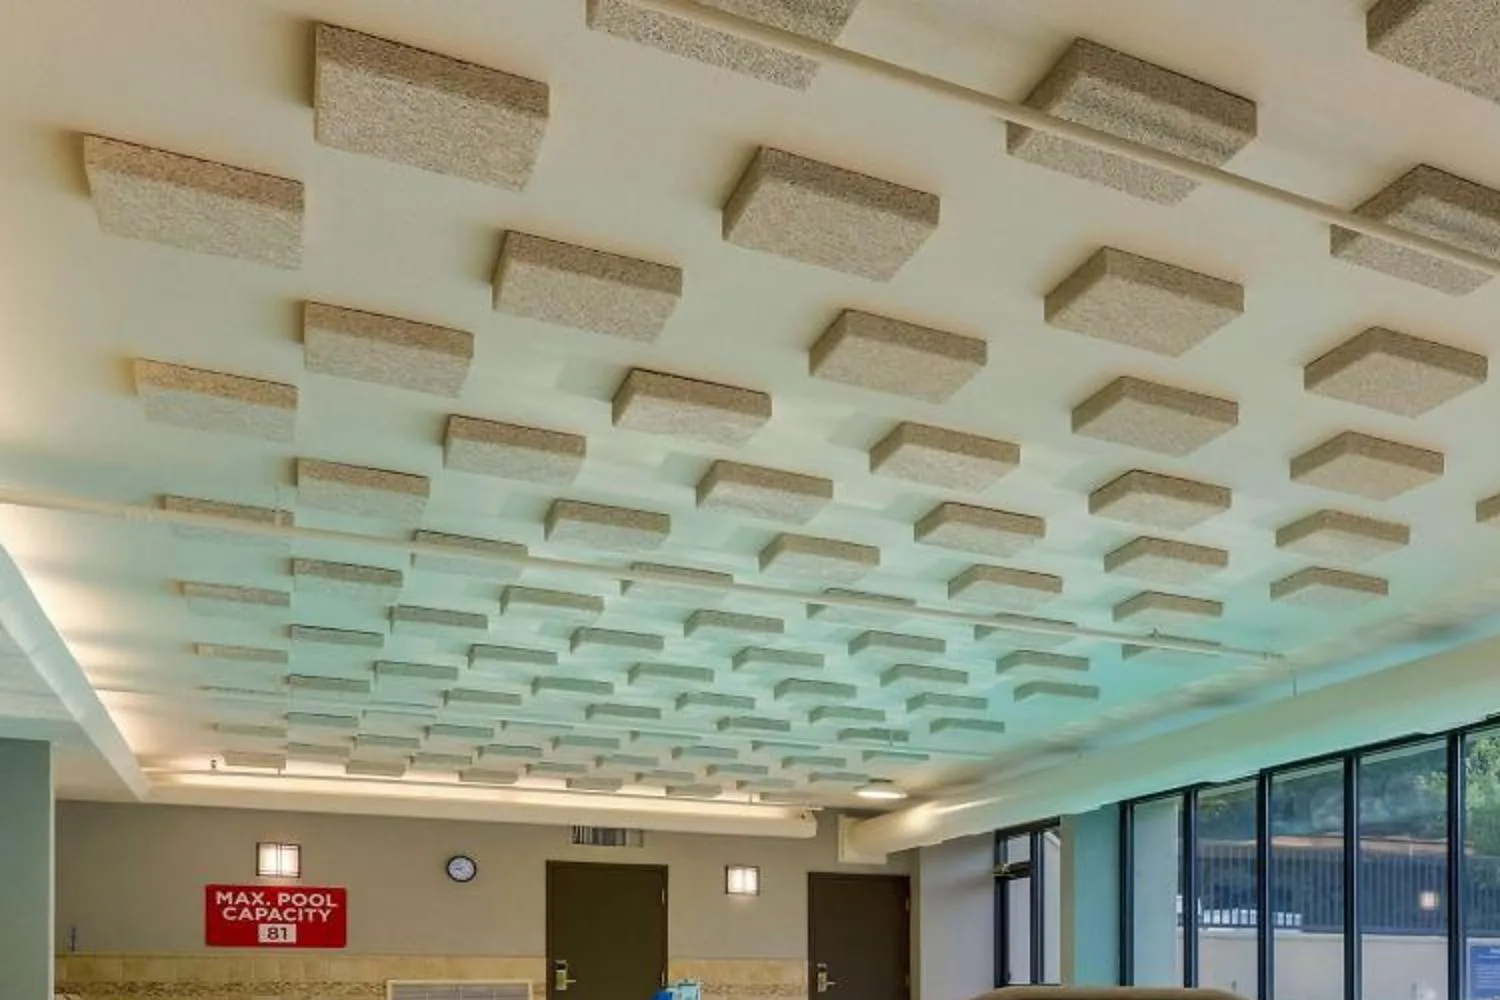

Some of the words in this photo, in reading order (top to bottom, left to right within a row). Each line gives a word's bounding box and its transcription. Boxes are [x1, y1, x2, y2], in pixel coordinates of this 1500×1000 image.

[215, 891, 271, 907] MAX.
[277, 892, 338, 908] POOL
[222, 907, 332, 923] CAPACITY
[266, 926, 288, 940] 81
